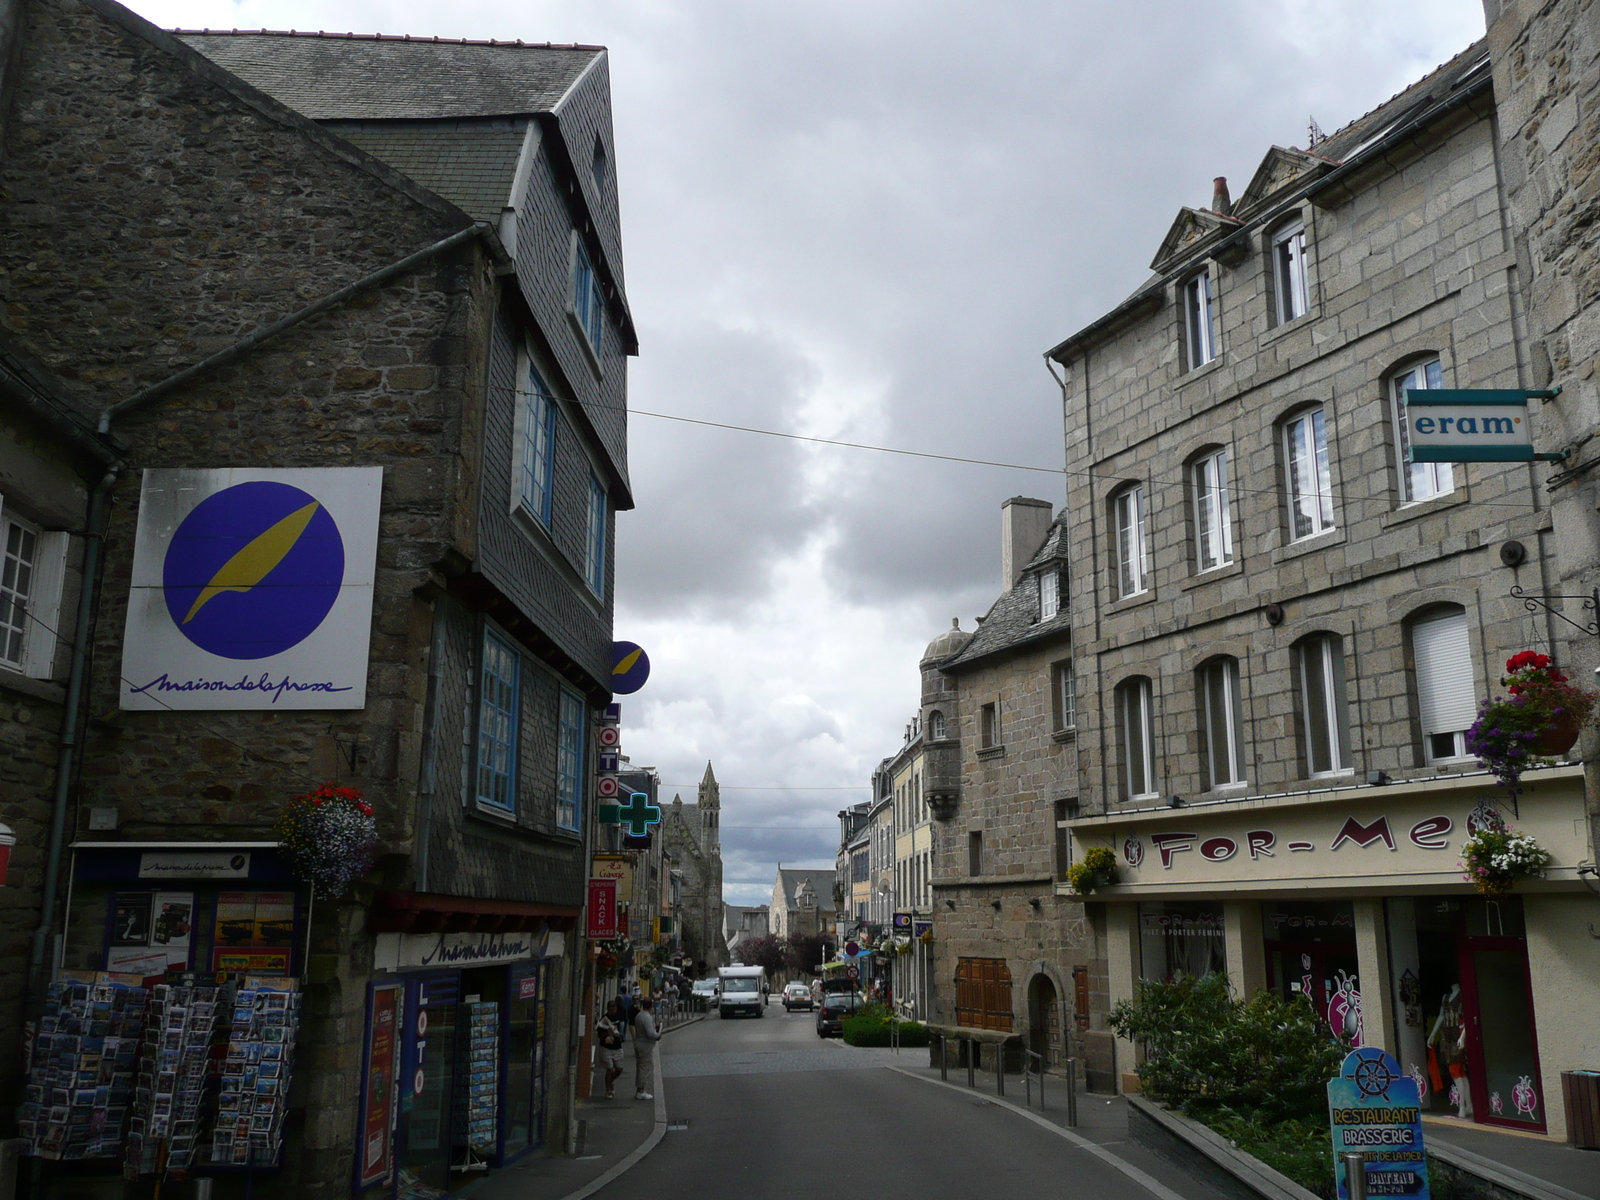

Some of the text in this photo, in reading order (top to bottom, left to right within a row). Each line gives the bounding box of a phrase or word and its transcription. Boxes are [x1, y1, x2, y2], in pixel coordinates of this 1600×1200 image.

[1415, 416, 1515, 434] eram
[598, 890, 606, 925] SNACK
[1168, 928, 1196, 936] PORTER
[521, 981, 535, 994] Keno
[414, 983, 428, 1096] LOTO
[1333, 1107, 1418, 1125] RESTAURANT
[1343, 1128, 1414, 1145] BRASSERIE
[1403, 1151, 1422, 1161] MER
[1368, 1172, 1415, 1185] BATEAU
